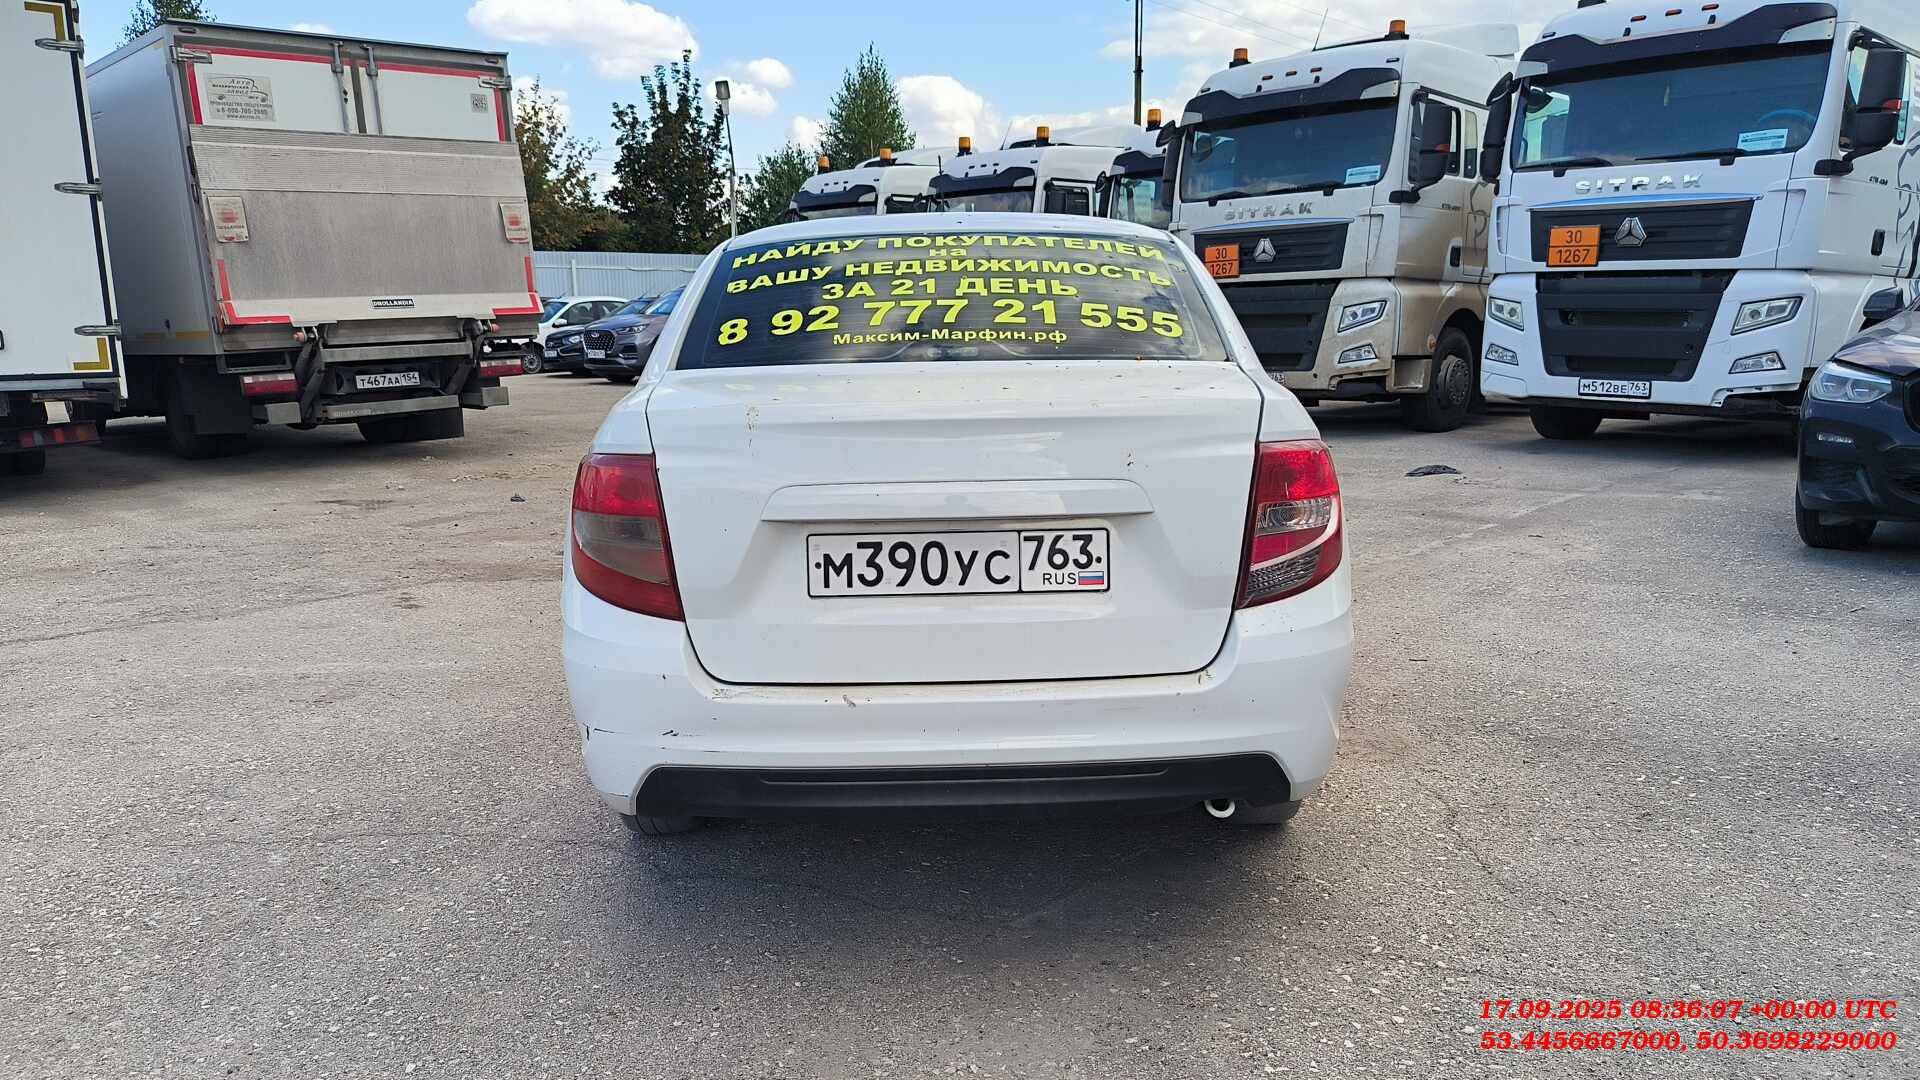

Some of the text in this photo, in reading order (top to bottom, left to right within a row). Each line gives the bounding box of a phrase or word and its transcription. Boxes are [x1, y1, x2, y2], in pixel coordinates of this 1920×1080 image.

[1575, 173, 1703, 194] SITRAK
[1224, 202, 1312, 220] SITRAK
[1565, 230, 1582, 244] 30
[732, 235, 1166, 269] НАЙДУ ПОКУПАТЕЛЕЙ
[929, 247, 967, 257] на
[1215, 247, 1227, 259] 30
[1556, 249, 1590, 264] 1267
[727, 259, 1173, 294] ВАШУ НЕДВИЖИМОСТЬ
[1210, 262, 1233, 276] 1267
[822, 277, 1079, 300] ЗА 21 ДЕНЬ
[718, 299, 1183, 346] 8 92 777 21 555
[833, 328, 1067, 345] Максим-Марфин.рф
[1582, 381, 1647, 393] М512ВЕ 763
[822, 534, 1094, 588] М390УС 763
[1042, 572, 1077, 585] RUS
